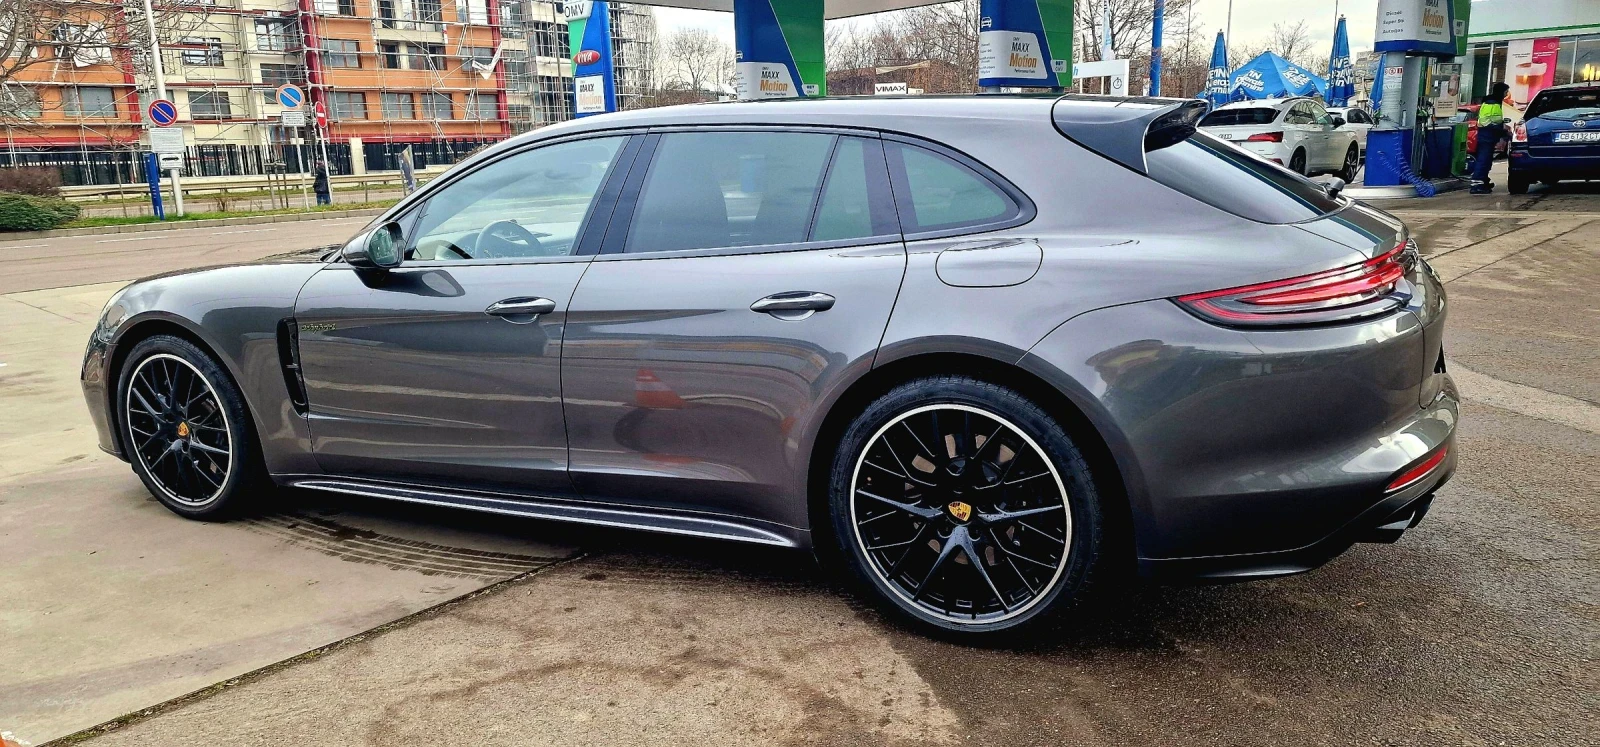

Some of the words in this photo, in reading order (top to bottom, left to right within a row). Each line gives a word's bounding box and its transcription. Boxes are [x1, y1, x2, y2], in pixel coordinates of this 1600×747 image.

[564, 3, 585, 18] OMV
[1011, 42, 1030, 52] MAXX
[577, 52, 592, 63] VIVA
[1009, 53, 1037, 68] Motion
[761, 71, 779, 79] MAXX
[760, 80, 788, 91] Motion
